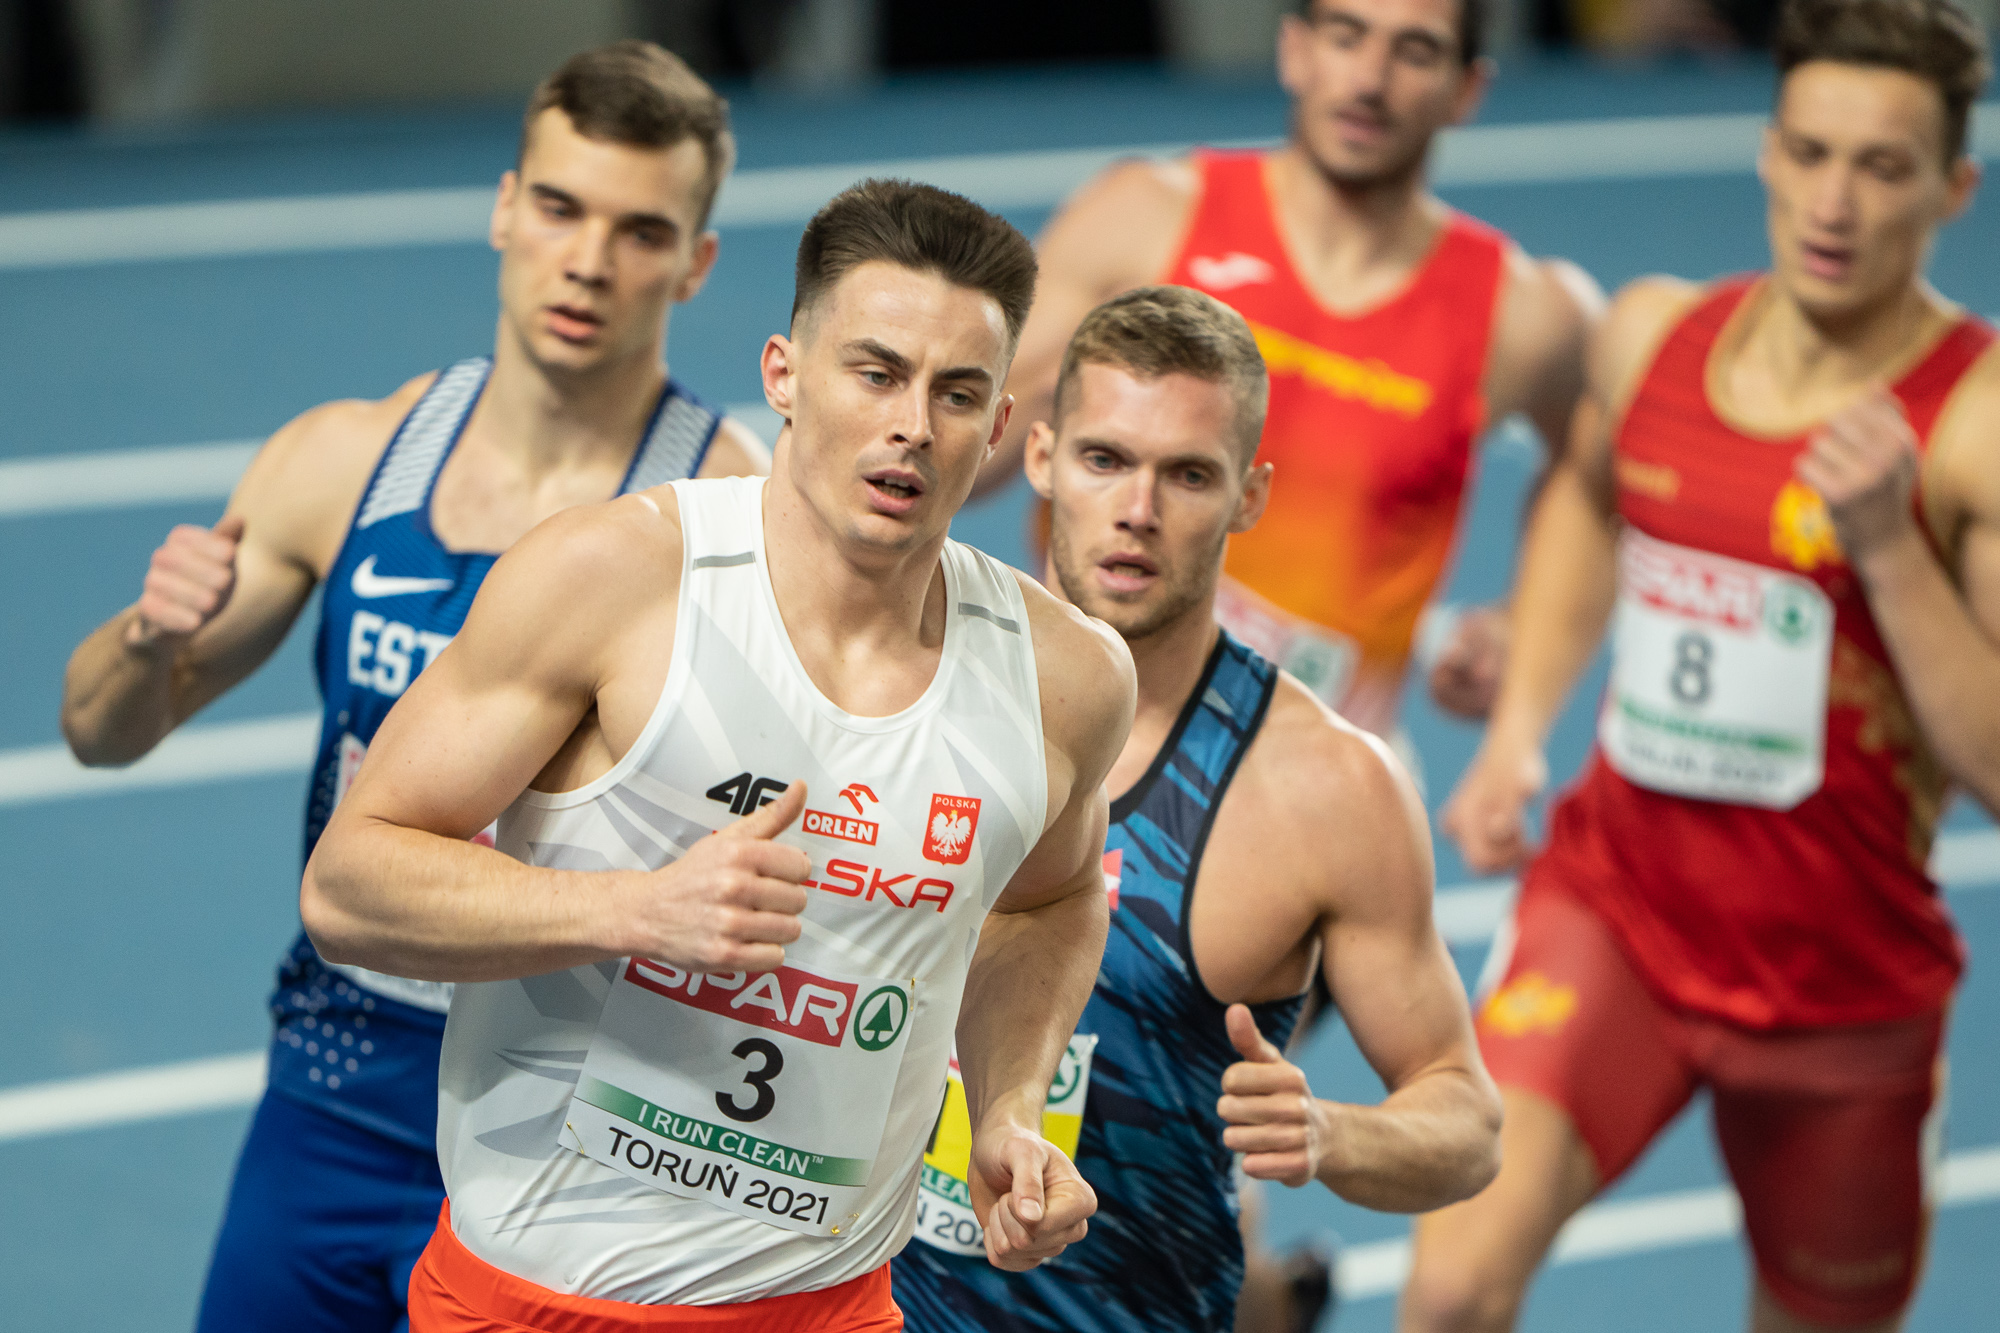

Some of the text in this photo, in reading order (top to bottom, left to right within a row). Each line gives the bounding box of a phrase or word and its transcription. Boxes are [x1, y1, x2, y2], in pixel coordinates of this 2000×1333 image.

[1668, 630, 1714, 707] 8
[705, 772, 789, 816] 4F
[935, 795, 978, 810] POLSKA
[806, 812, 875, 843] ORLEN
[715, 1037, 785, 1123] 3
[637, 1103, 649, 1123] I
[651, 1112, 713, 1146] RUN
[608, 1126, 830, 1225] TORUŃ 2021
